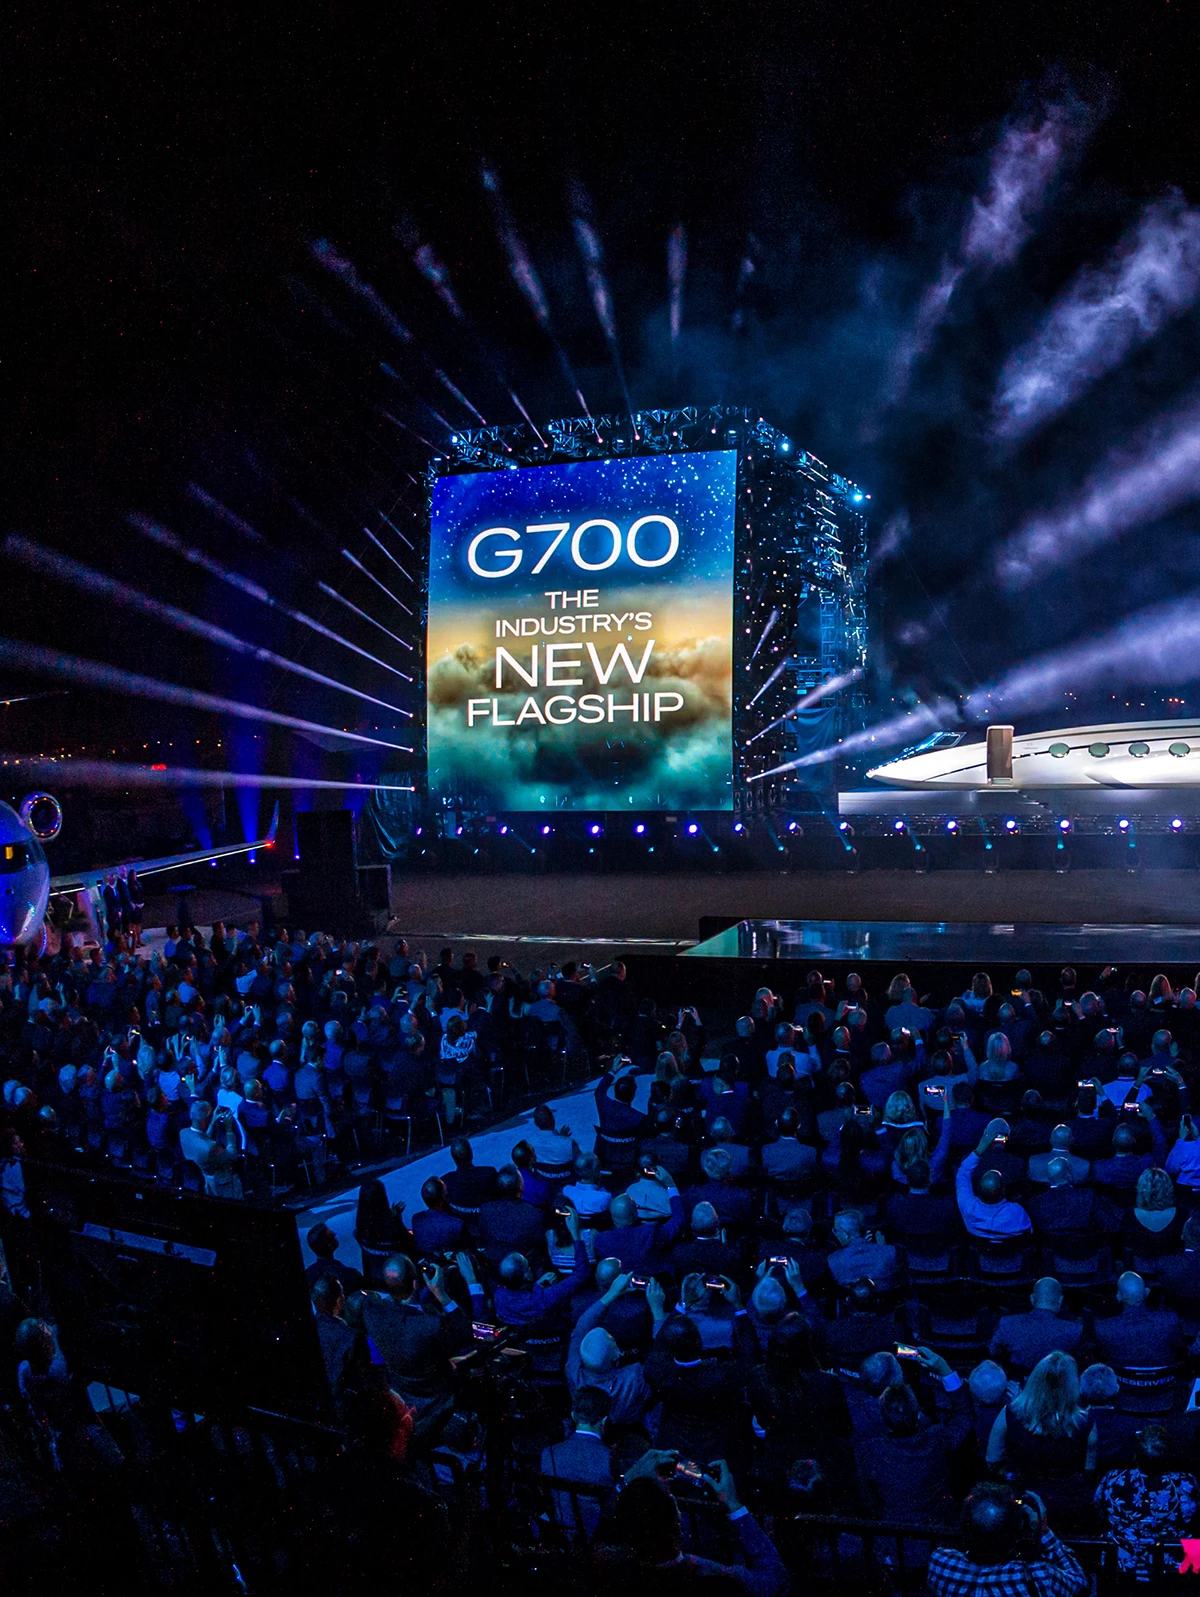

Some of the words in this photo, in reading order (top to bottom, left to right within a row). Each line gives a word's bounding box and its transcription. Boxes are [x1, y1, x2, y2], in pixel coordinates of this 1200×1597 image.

[468, 515, 679, 578] G700
[544, 589, 599, 610] THE
[496, 611, 653, 638] INDUSTRY'S
[496, 639, 655, 689] NEW
[468, 692, 684, 727] FLAGSHIP
